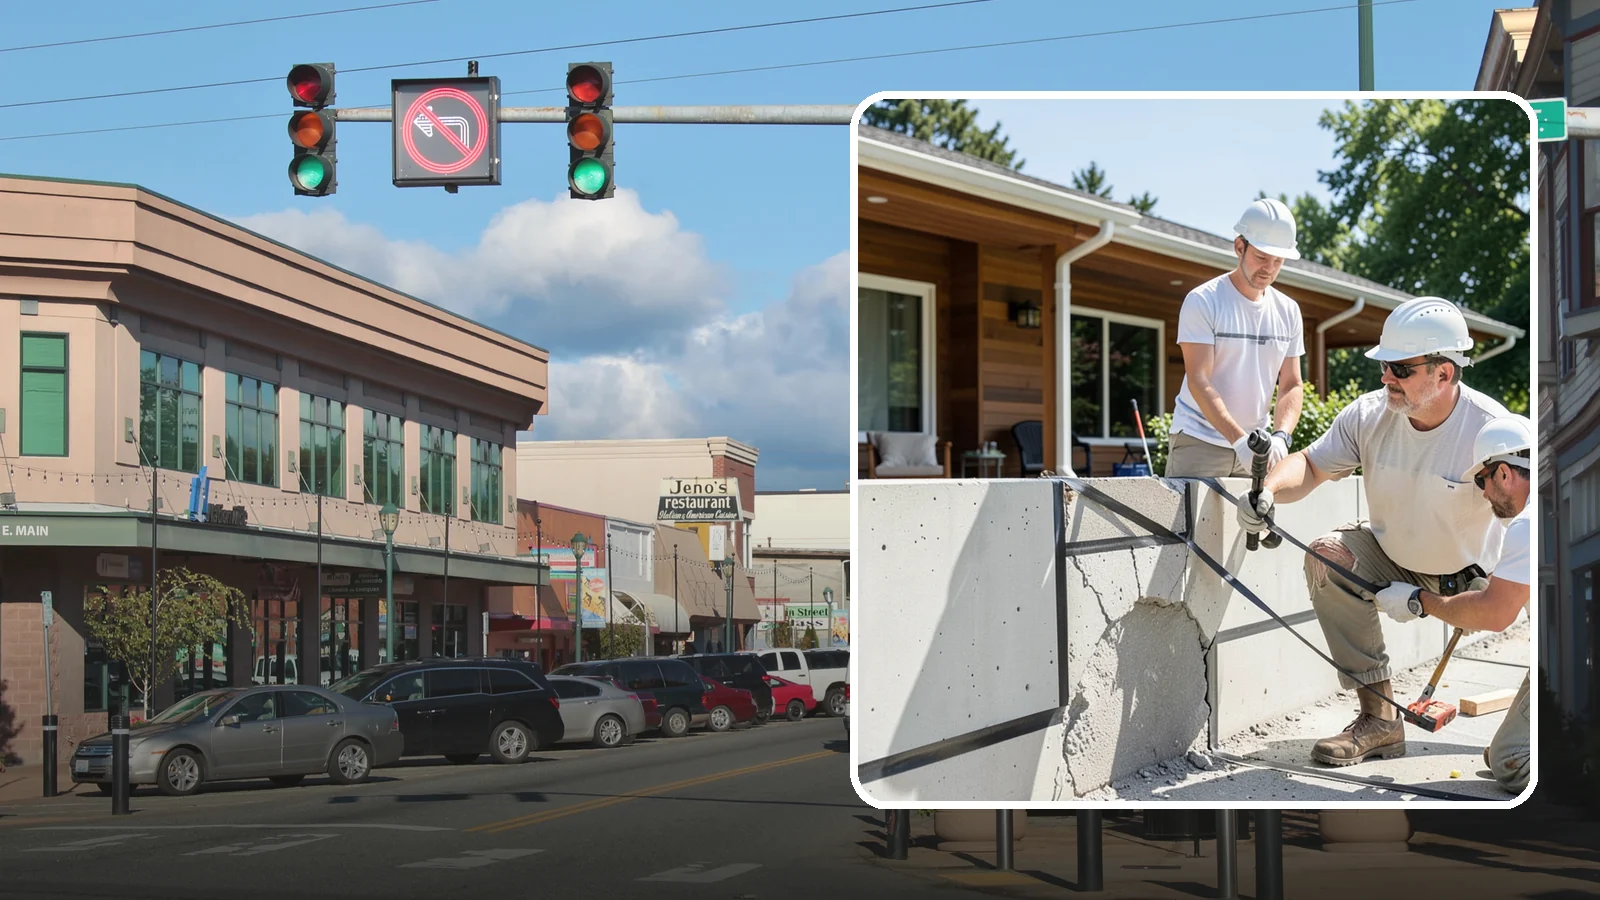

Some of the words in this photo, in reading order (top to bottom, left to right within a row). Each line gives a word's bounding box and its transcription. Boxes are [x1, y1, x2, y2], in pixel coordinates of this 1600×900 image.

[670, 480, 728, 494] Jeno's
[665, 496, 731, 509] restaurant
[659, 509, 681, 519] Italian
[686, 509, 715, 519] American
[715, 509, 738, 518] Cuisine
[2, 525, 13, 536] E.
[15, 525, 49, 536] MAIN
[797, 607, 828, 617] Street
